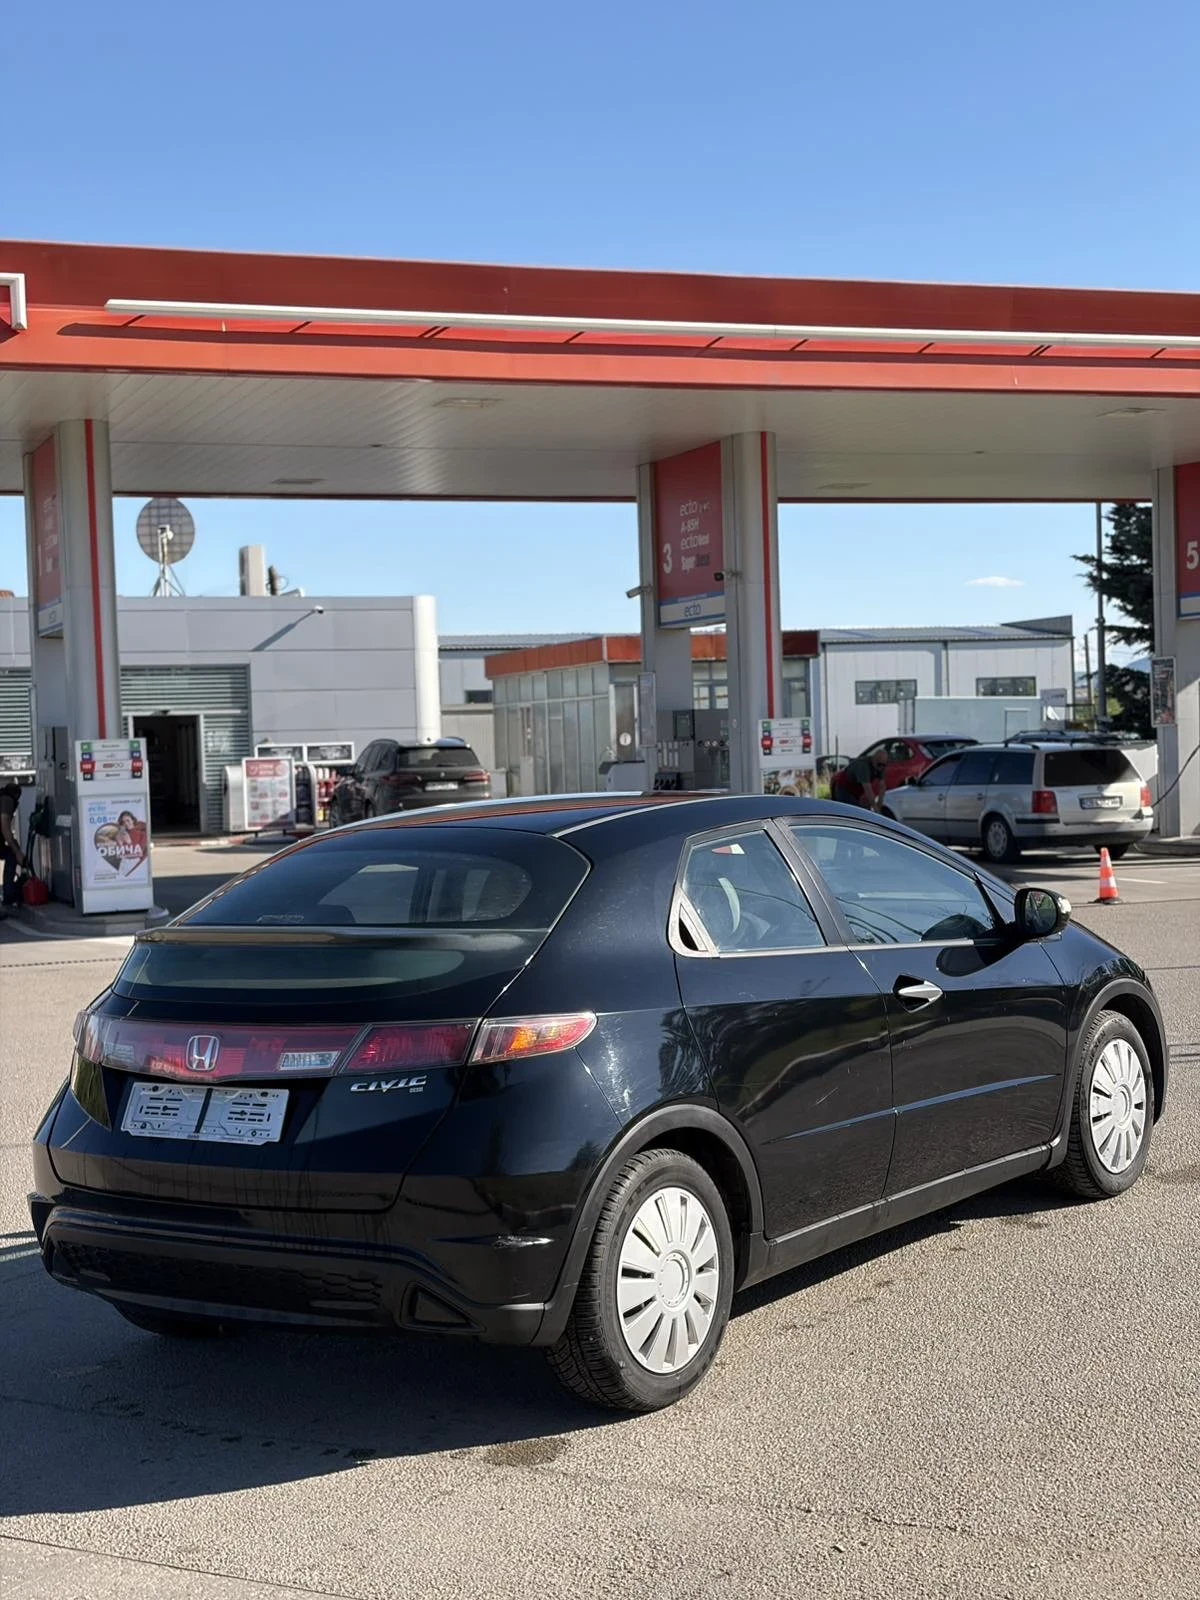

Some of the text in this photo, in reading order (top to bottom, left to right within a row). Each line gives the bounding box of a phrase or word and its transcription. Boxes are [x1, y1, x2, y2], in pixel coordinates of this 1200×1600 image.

[663, 543, 672, 574] 3
[1186, 541, 1199, 570] 5
[98, 843, 143, 858] ОБИЧА
[350, 1074, 427, 1093] CIVIC
